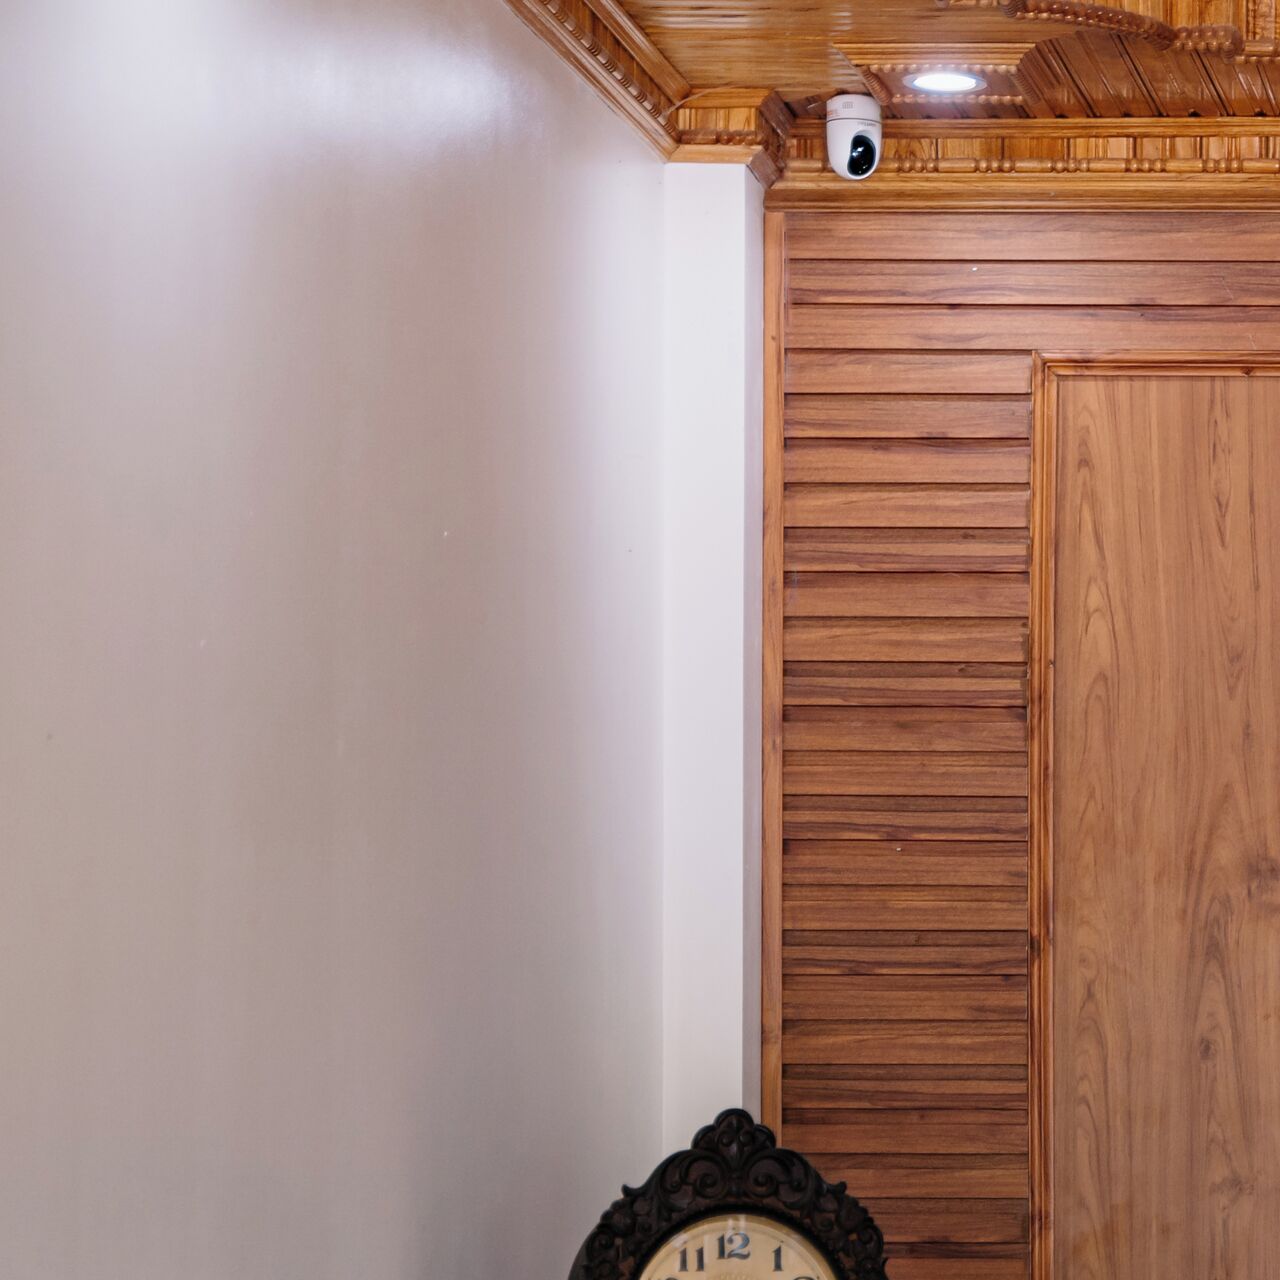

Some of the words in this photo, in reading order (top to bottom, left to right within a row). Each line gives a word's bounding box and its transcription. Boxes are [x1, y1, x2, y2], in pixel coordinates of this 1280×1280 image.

[716, 1232, 751, 1260] 12
[773, 1246, 783, 1272] 1
[678, 1247, 704, 1272] 11
